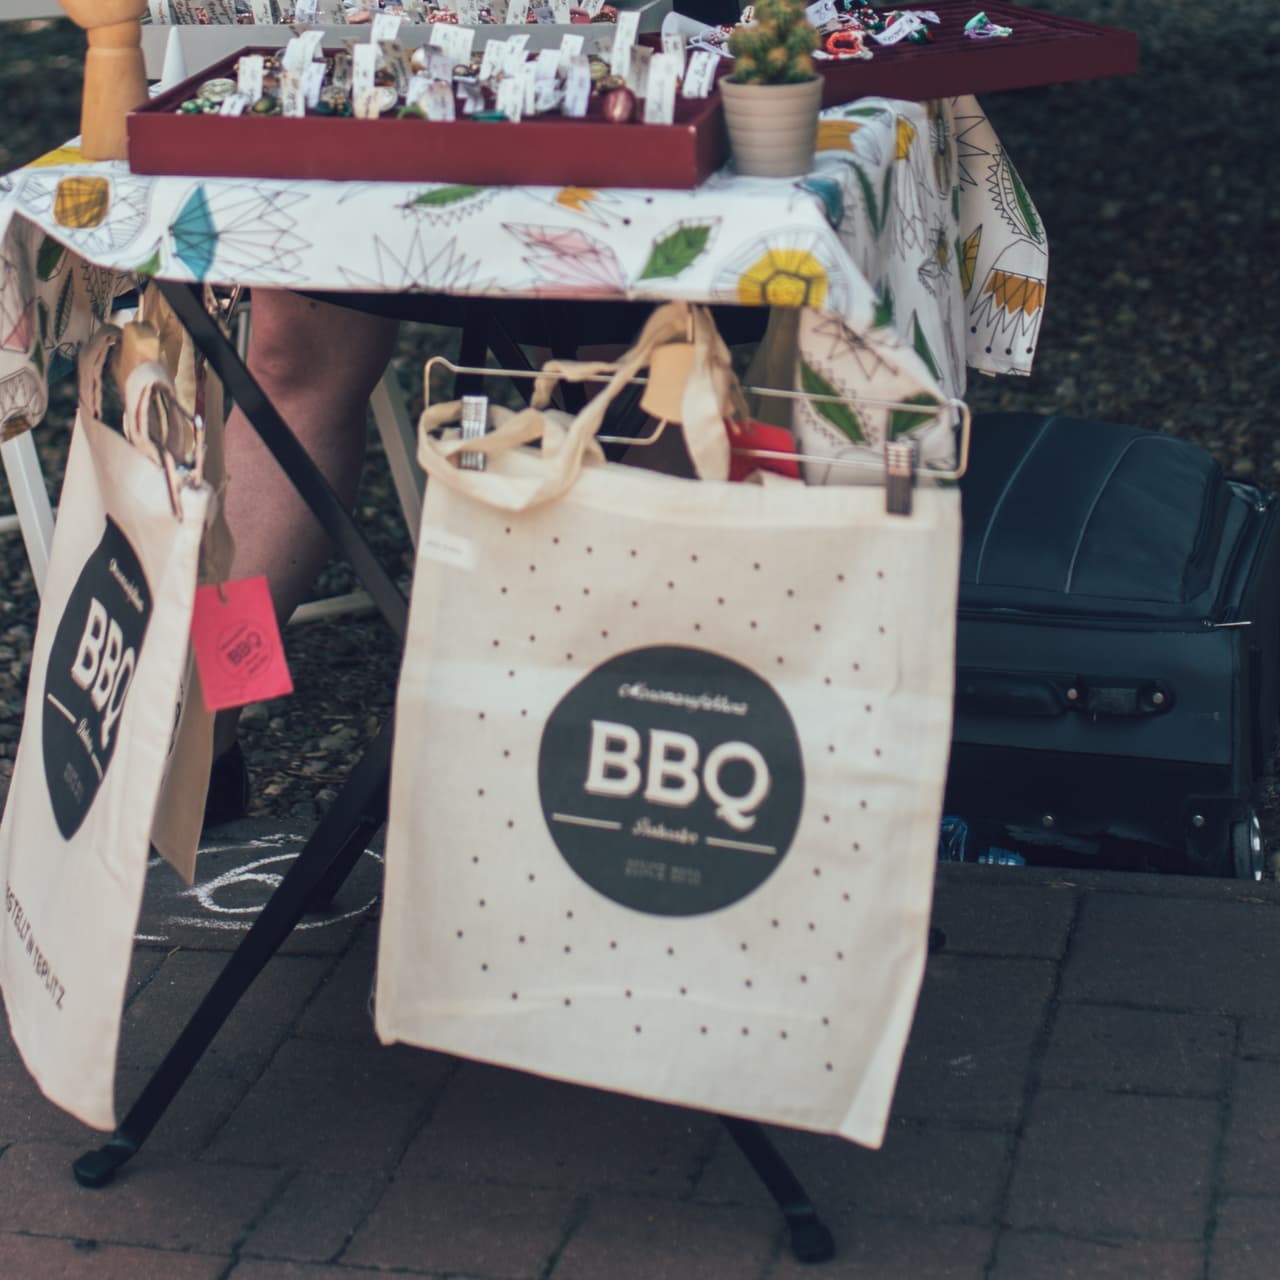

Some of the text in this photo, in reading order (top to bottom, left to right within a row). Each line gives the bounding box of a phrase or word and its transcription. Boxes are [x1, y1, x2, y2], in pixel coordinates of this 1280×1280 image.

[71, 596, 136, 751] BBQ
[227, 631, 261, 667] BBQ
[584, 718, 771, 833] BBQ
